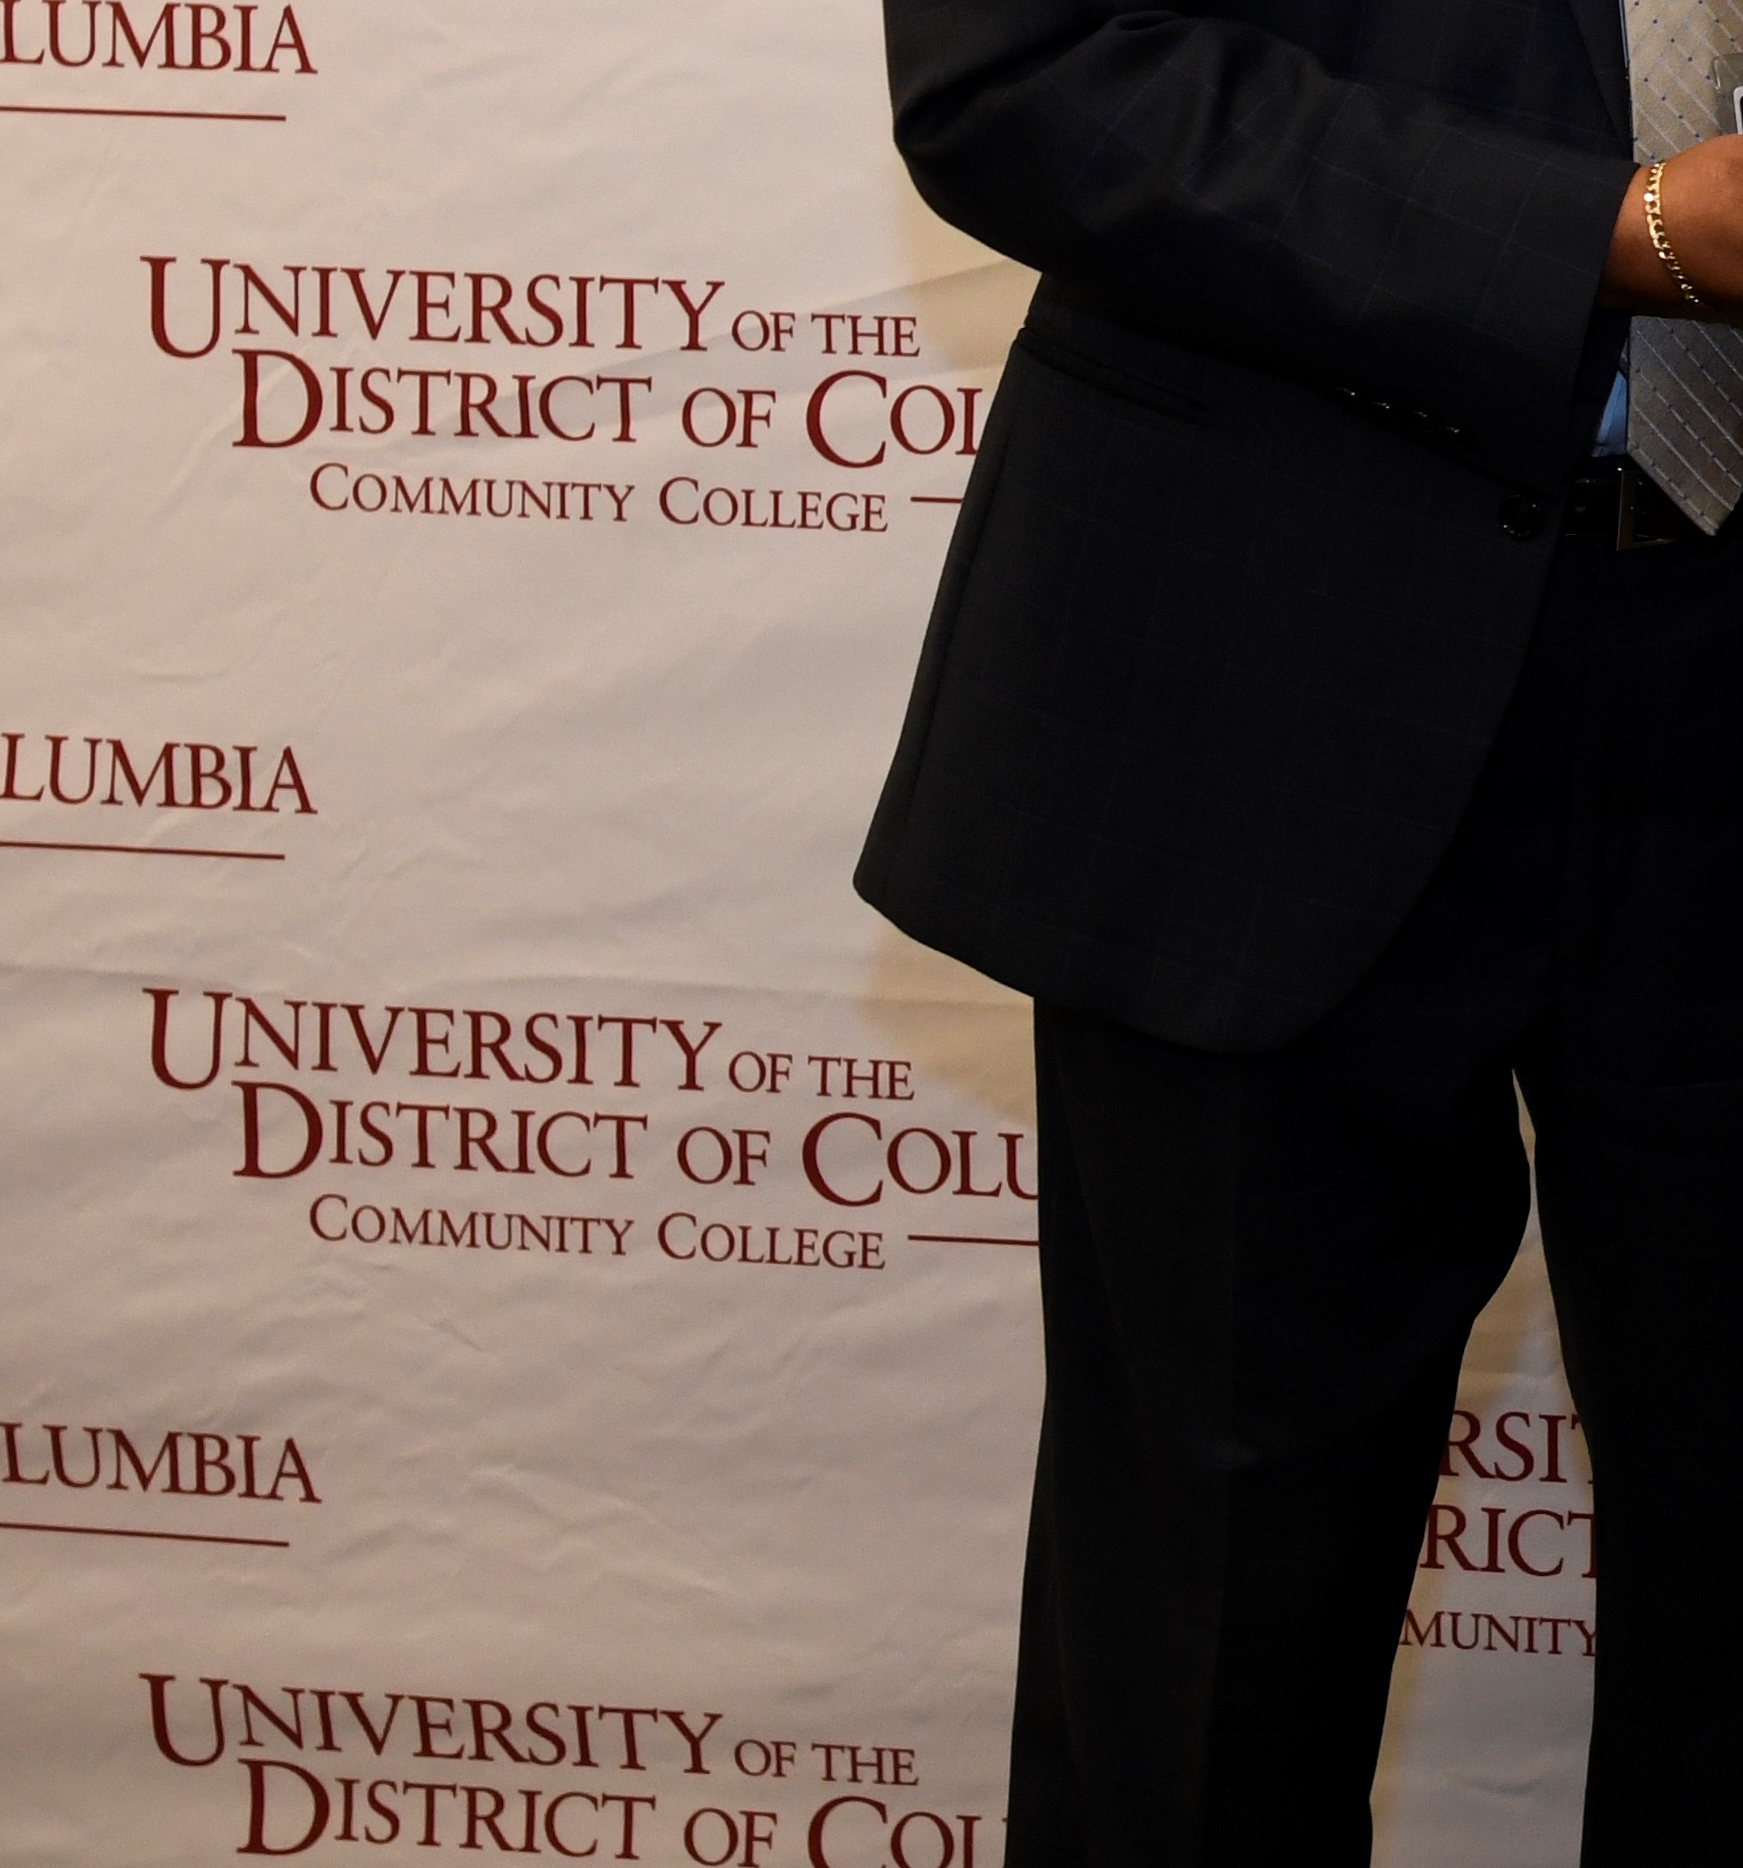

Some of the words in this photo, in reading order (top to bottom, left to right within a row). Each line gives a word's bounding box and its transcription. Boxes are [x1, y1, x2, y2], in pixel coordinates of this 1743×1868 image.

[140, 255, 726, 360] UNIVERSITY
[731, 311, 796, 353] OF
[811, 312, 921, 359] THE
[232, 348, 653, 449] DISTRICT
[681, 386, 777, 449] OF
[309, 462, 636, 523] COMMUNITY
[659, 475, 889, 532] COLLEGE
[0, 732, 317, 815] LUMBIA
[142, 986, 723, 1093] UNIVERSITY
[728, 1051, 794, 1094] OF
[808, 1055, 915, 1102] THE
[232, 1080, 649, 1180] DISTRICT
[676, 1125, 771, 1187] OF
[803, 1112, 1039, 1207] COLU
[309, 1194, 636, 1258] COMMUNITY
[657, 1211, 886, 1270] COLLEGE
[0, 1421, 322, 1504] LUMBIA
[1401, 1610, 1598, 1657] MUNITY
[139, 1672, 723, 1774] UNIVERSITY
[734, 1739, 797, 1778] OF
[811, 1742, 919, 1786] THE
[236, 1757, 656, 1864] DISTRICT
[683, 1806, 779, 1867] OF
